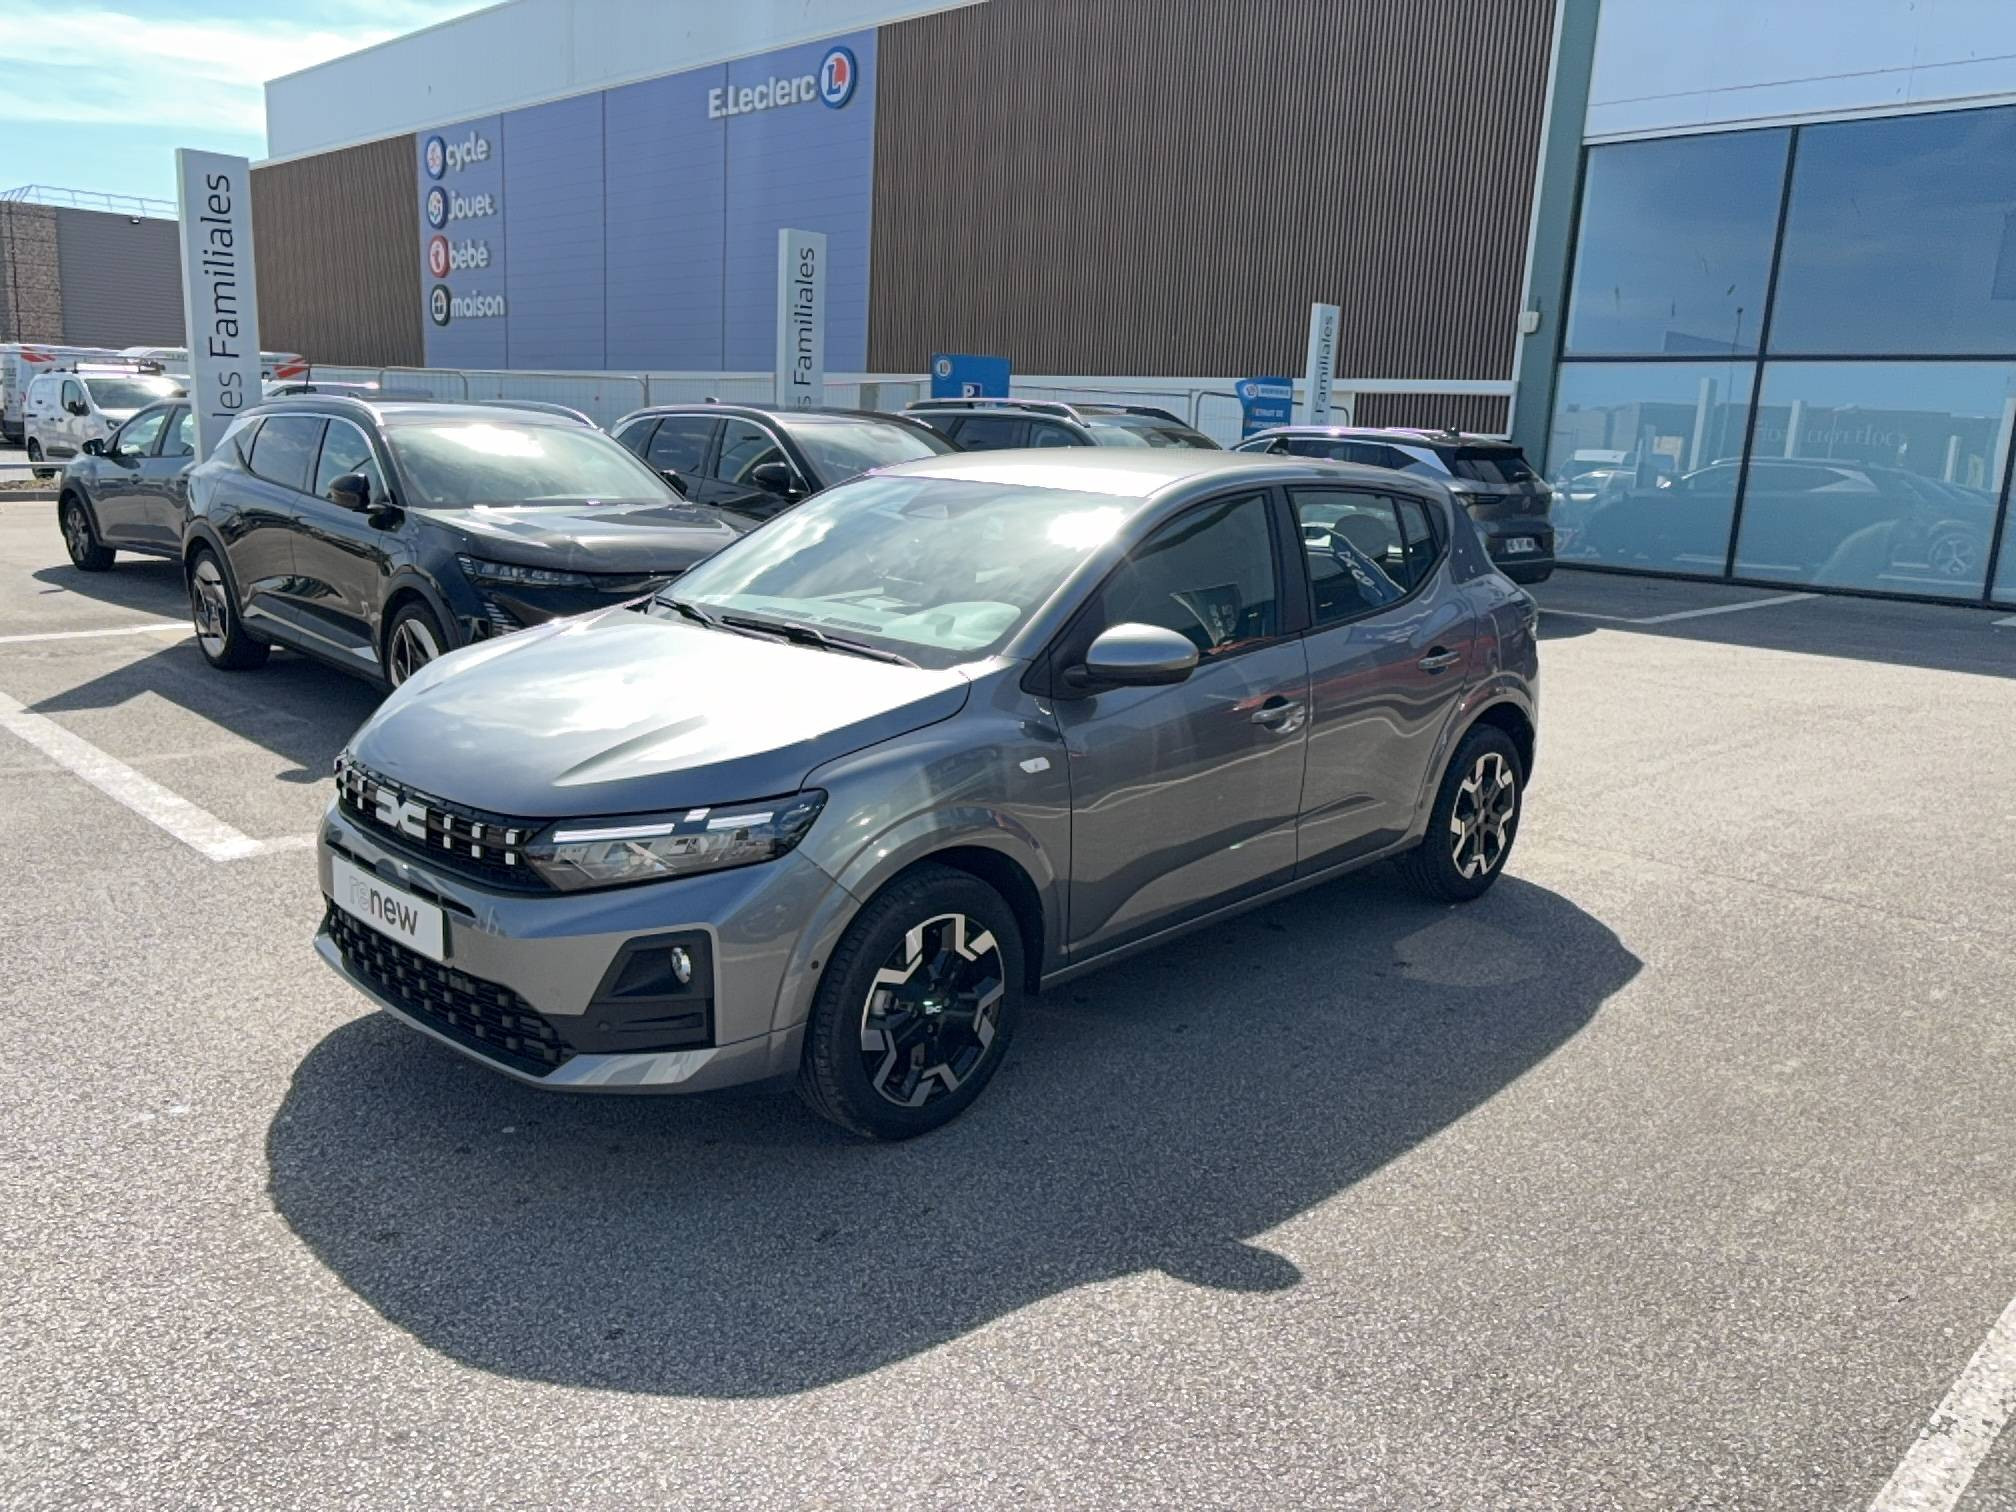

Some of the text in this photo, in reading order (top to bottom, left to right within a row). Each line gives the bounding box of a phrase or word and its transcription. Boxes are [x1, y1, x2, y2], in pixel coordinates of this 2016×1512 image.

[708, 75, 816, 119] E.Leclerc
[446, 131, 489, 171] cycle
[448, 191, 495, 220] jouet
[449, 240, 489, 269] bébé
[200, 174, 243, 417] les Familiales
[450, 291, 505, 317] maison
[793, 247, 815, 386] Familiales
[1315, 315, 1333, 413] Familiales
[348, 875, 418, 936] renew
